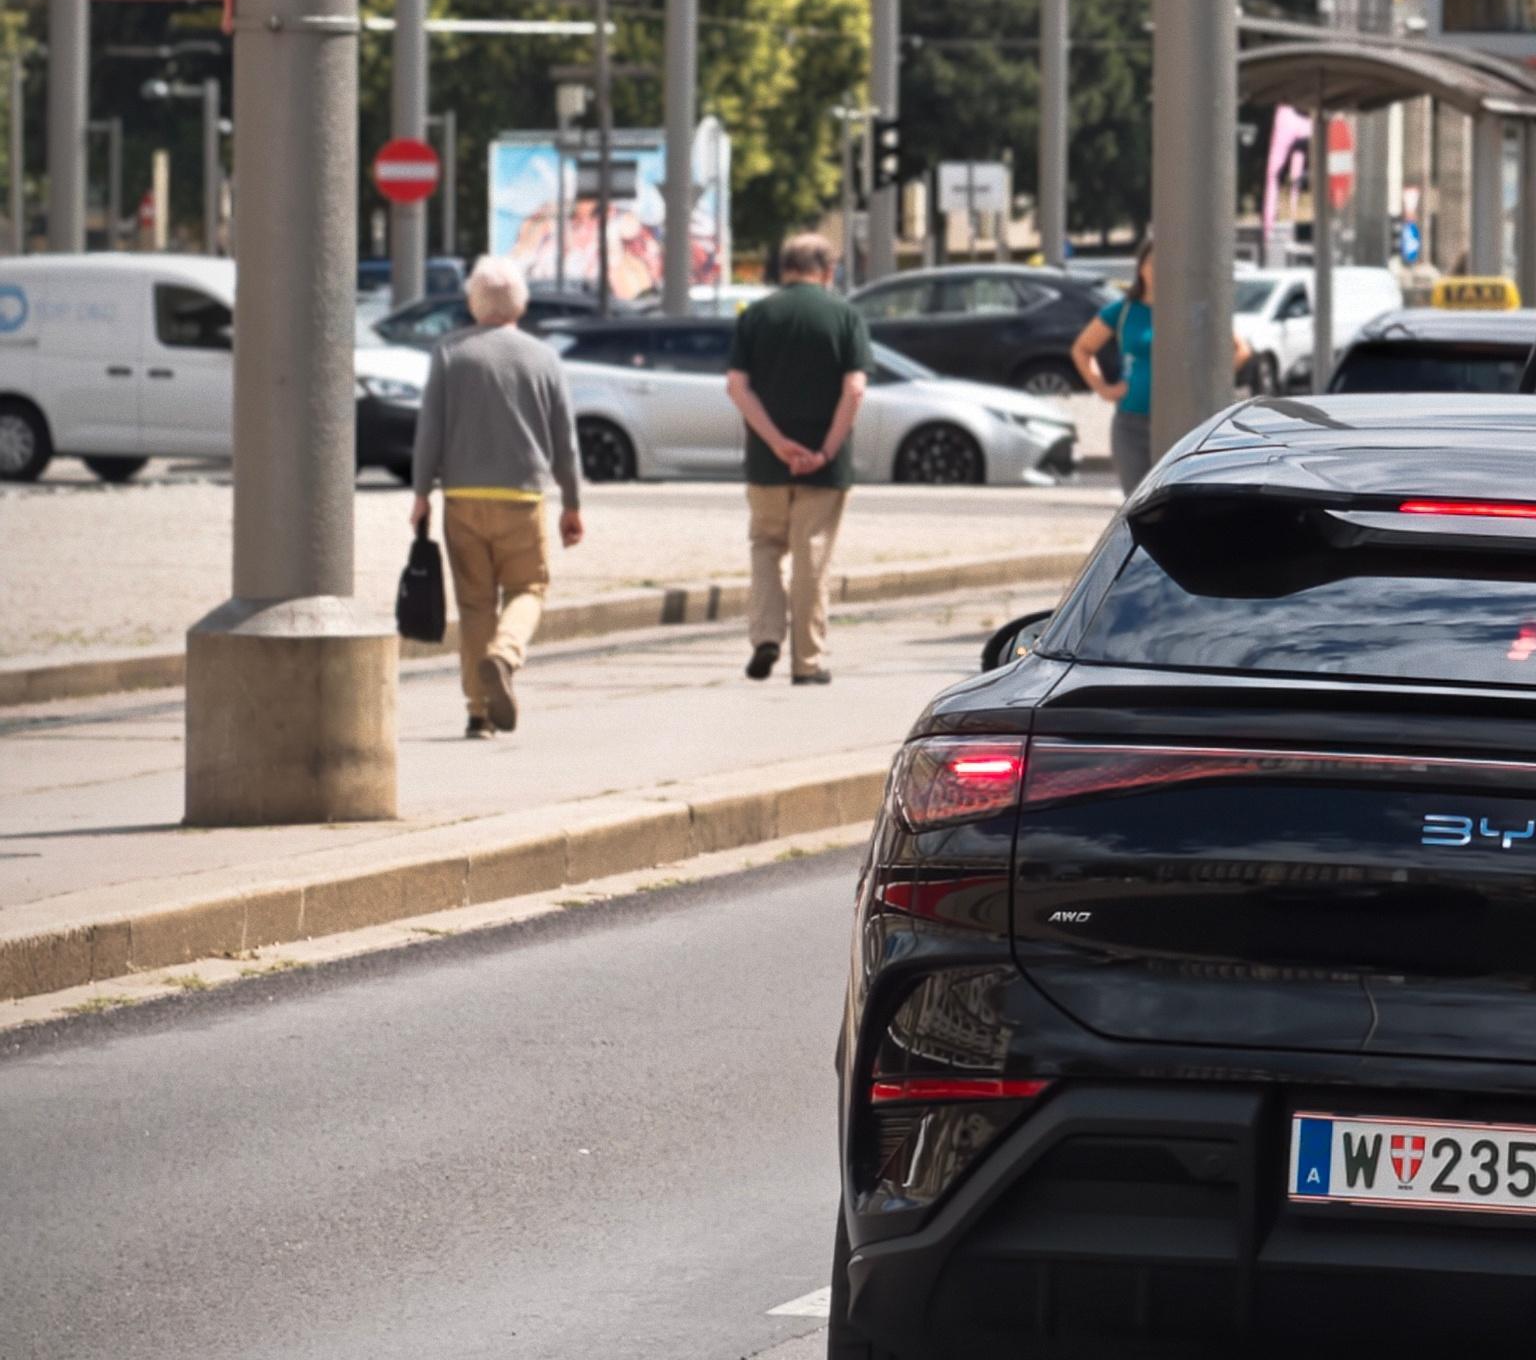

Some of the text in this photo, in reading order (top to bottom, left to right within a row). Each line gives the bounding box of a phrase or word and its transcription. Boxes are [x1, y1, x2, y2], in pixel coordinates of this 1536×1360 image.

[1048, 911, 1092, 922] AWD
[1343, 1131, 1383, 1189] W
[1306, 1167, 1321, 1184] A
